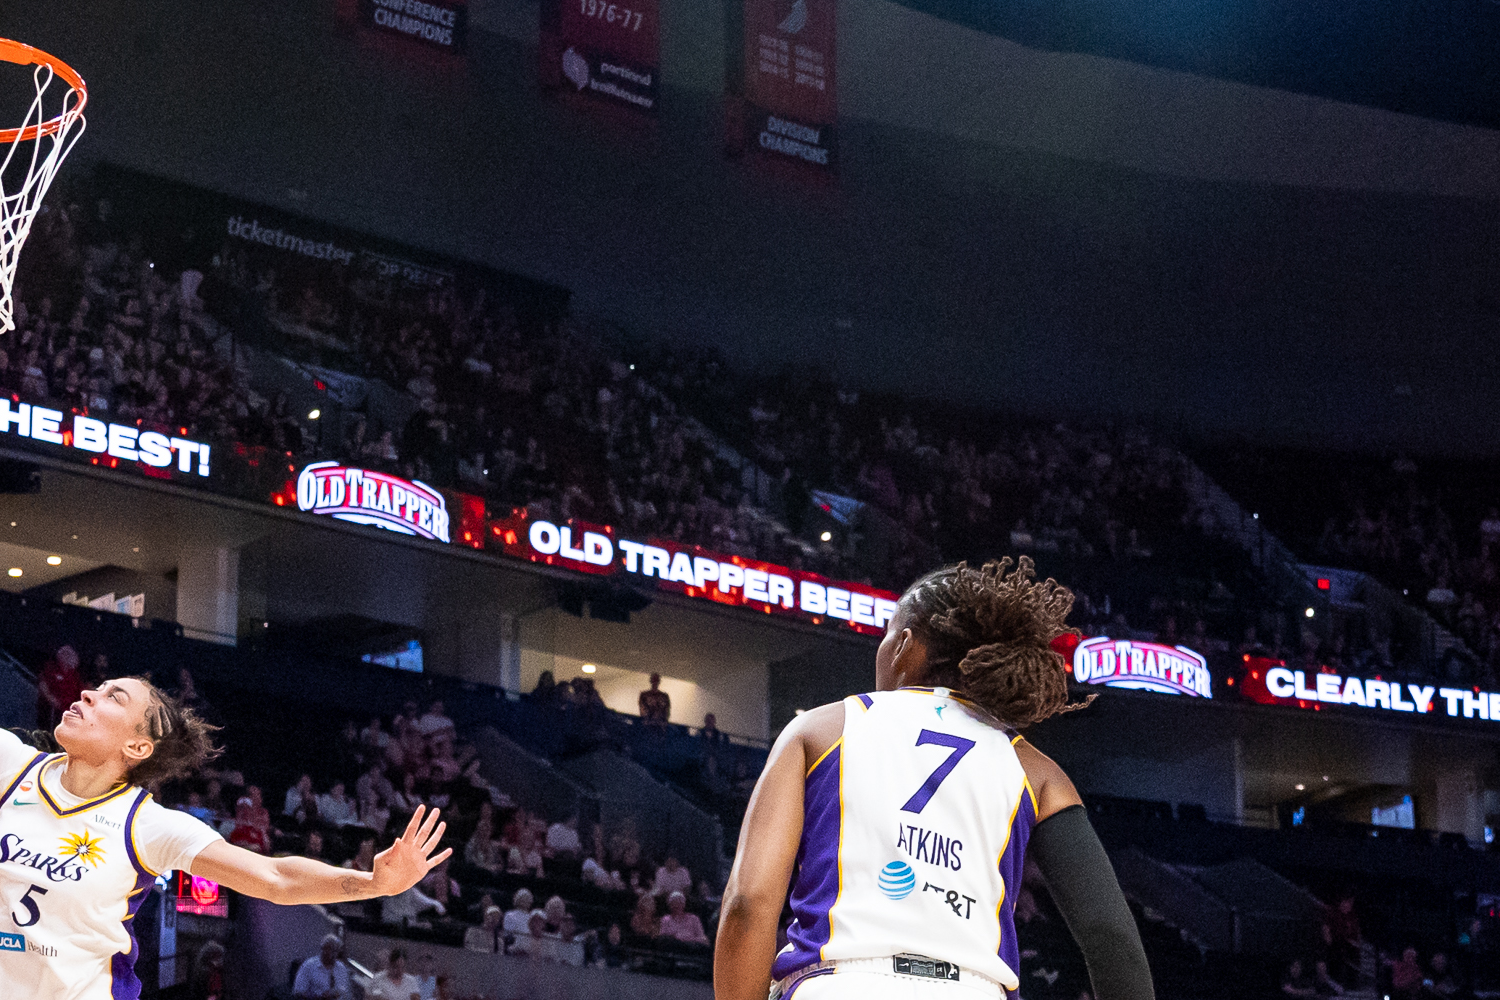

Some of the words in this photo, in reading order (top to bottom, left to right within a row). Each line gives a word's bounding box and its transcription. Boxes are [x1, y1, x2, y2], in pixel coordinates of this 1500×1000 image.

[373, 0, 455, 27] NFERENCE
[374, 7, 453, 45] CHAMPIONS
[227, 216, 353, 266] ticketmaster
[73, 415, 210, 477] BEST!
[300, 472, 345, 511] OLD
[345, 468, 448, 542] TRAPPER
[529, 520, 613, 566] OLD
[619, 540, 794, 607] TRAPPER
[800, 580, 897, 628] BEEF
[1076, 647, 1116, 682] OLD
[1115, 641, 1209, 697] TRAPPER
[1266, 667, 1434, 713] CLEARLY
[900, 728, 976, 814] 7
[92, 814, 122, 830] Albert
[897, 822, 964, 872] ATKINS
[12, 884, 48, 927] 5
[923, 881, 977, 919] &T
